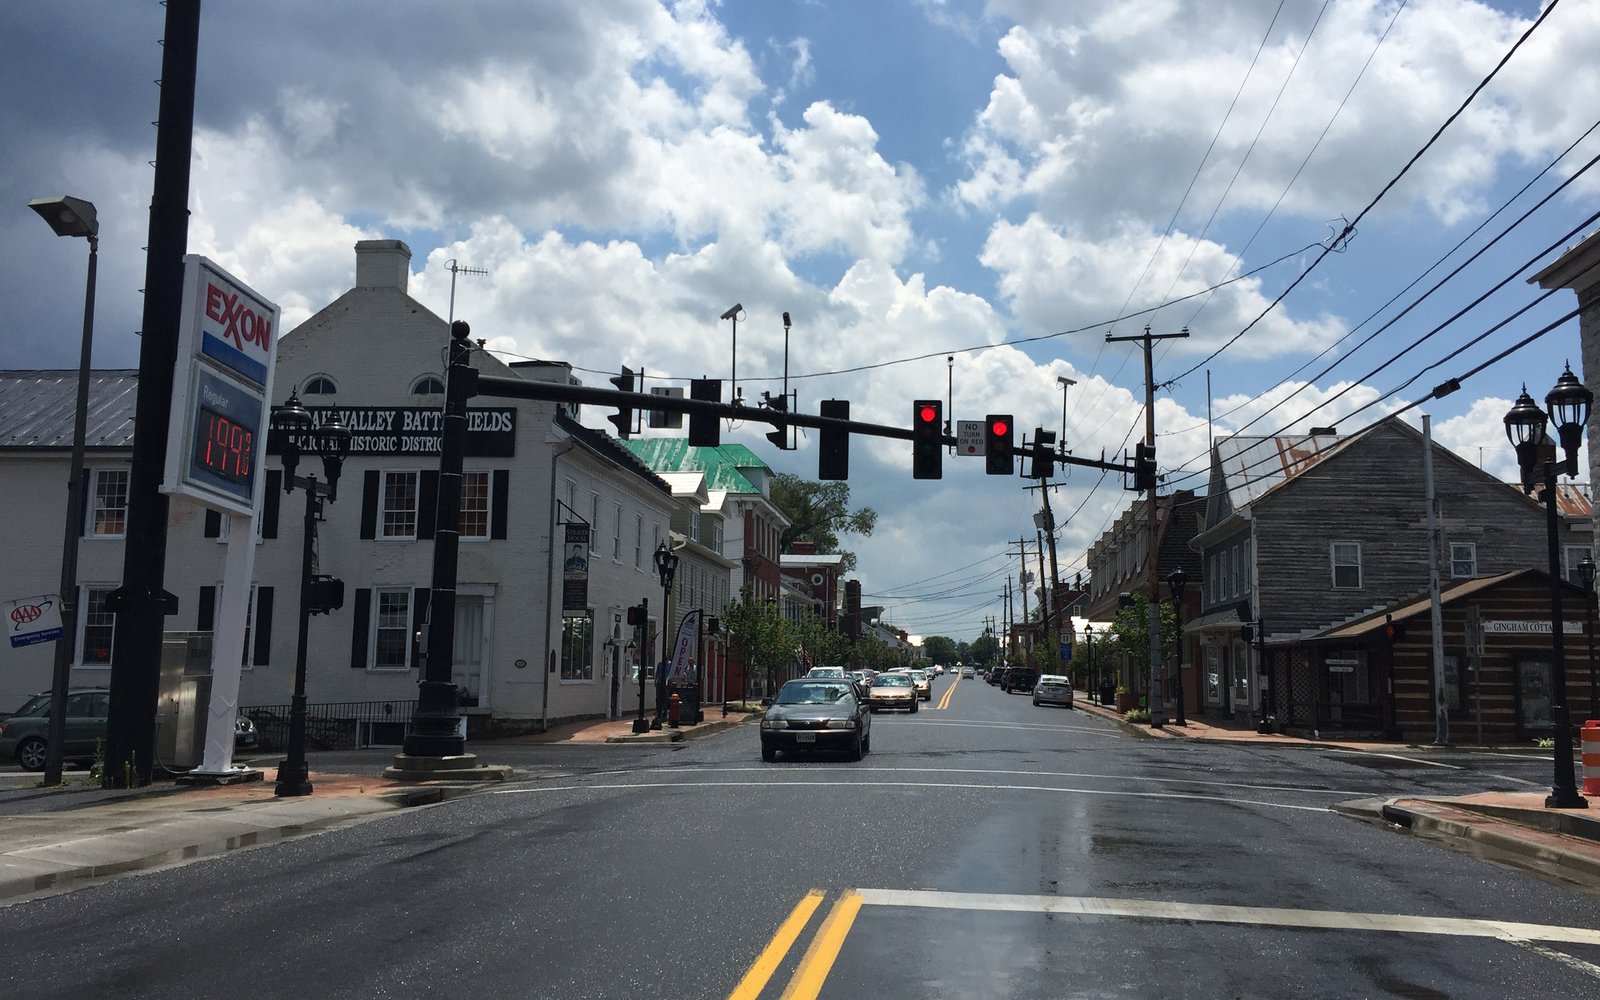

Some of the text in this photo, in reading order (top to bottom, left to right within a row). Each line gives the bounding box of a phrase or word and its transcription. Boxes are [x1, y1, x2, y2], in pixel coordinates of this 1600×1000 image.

[206, 282, 272, 351] EXXON
[203, 385, 229, 408] Regular
[340, 410, 396, 431] VALLEY
[403, 411, 512, 432] BATTIELDS
[401, 436, 443, 452] DISTRIC
[15, 605, 38, 622] AAA
[1494, 622, 1529, 632] GINGHAM
[674, 637, 689, 676] OPEN
